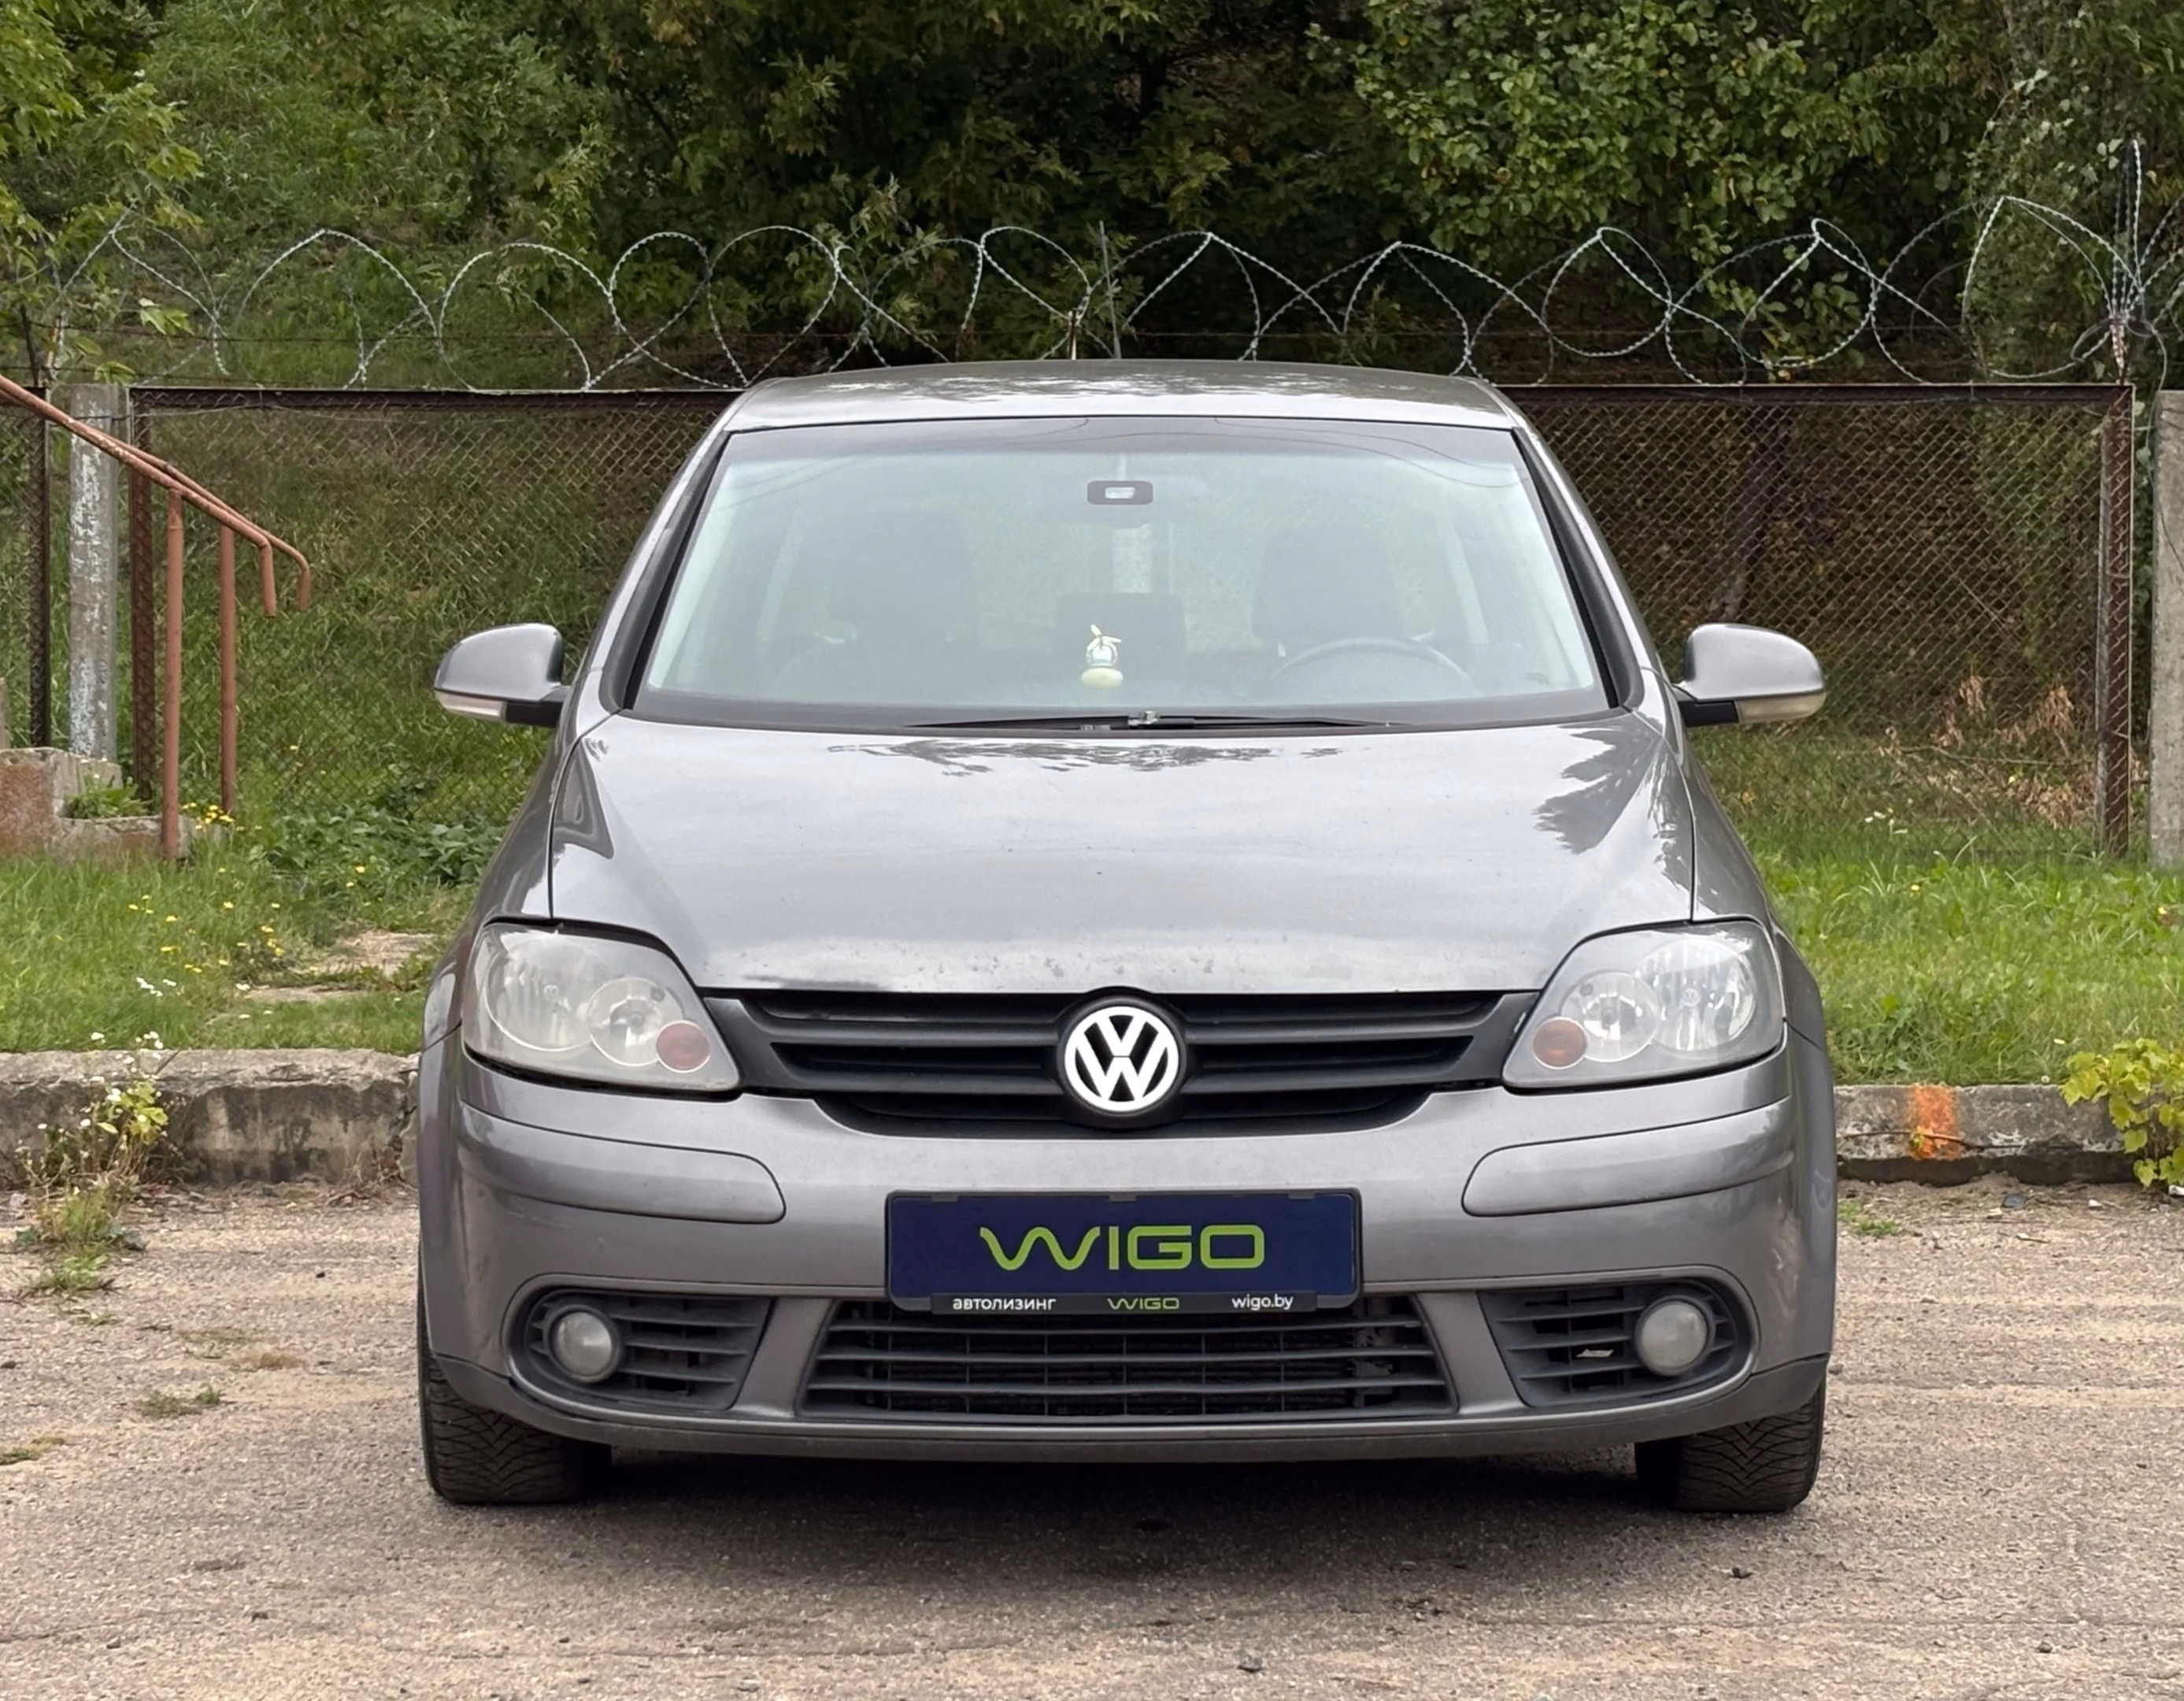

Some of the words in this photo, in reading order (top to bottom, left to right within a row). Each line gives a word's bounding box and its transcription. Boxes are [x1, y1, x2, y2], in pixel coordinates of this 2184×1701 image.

[1066, 1007, 1177, 1110] VW
[979, 1225, 1265, 1270] WIGO
[953, 1298, 1057, 1310] автолизинг
[1107, 1297, 1180, 1310] WIGO
[1231, 1293, 1294, 1311] wigo.by
